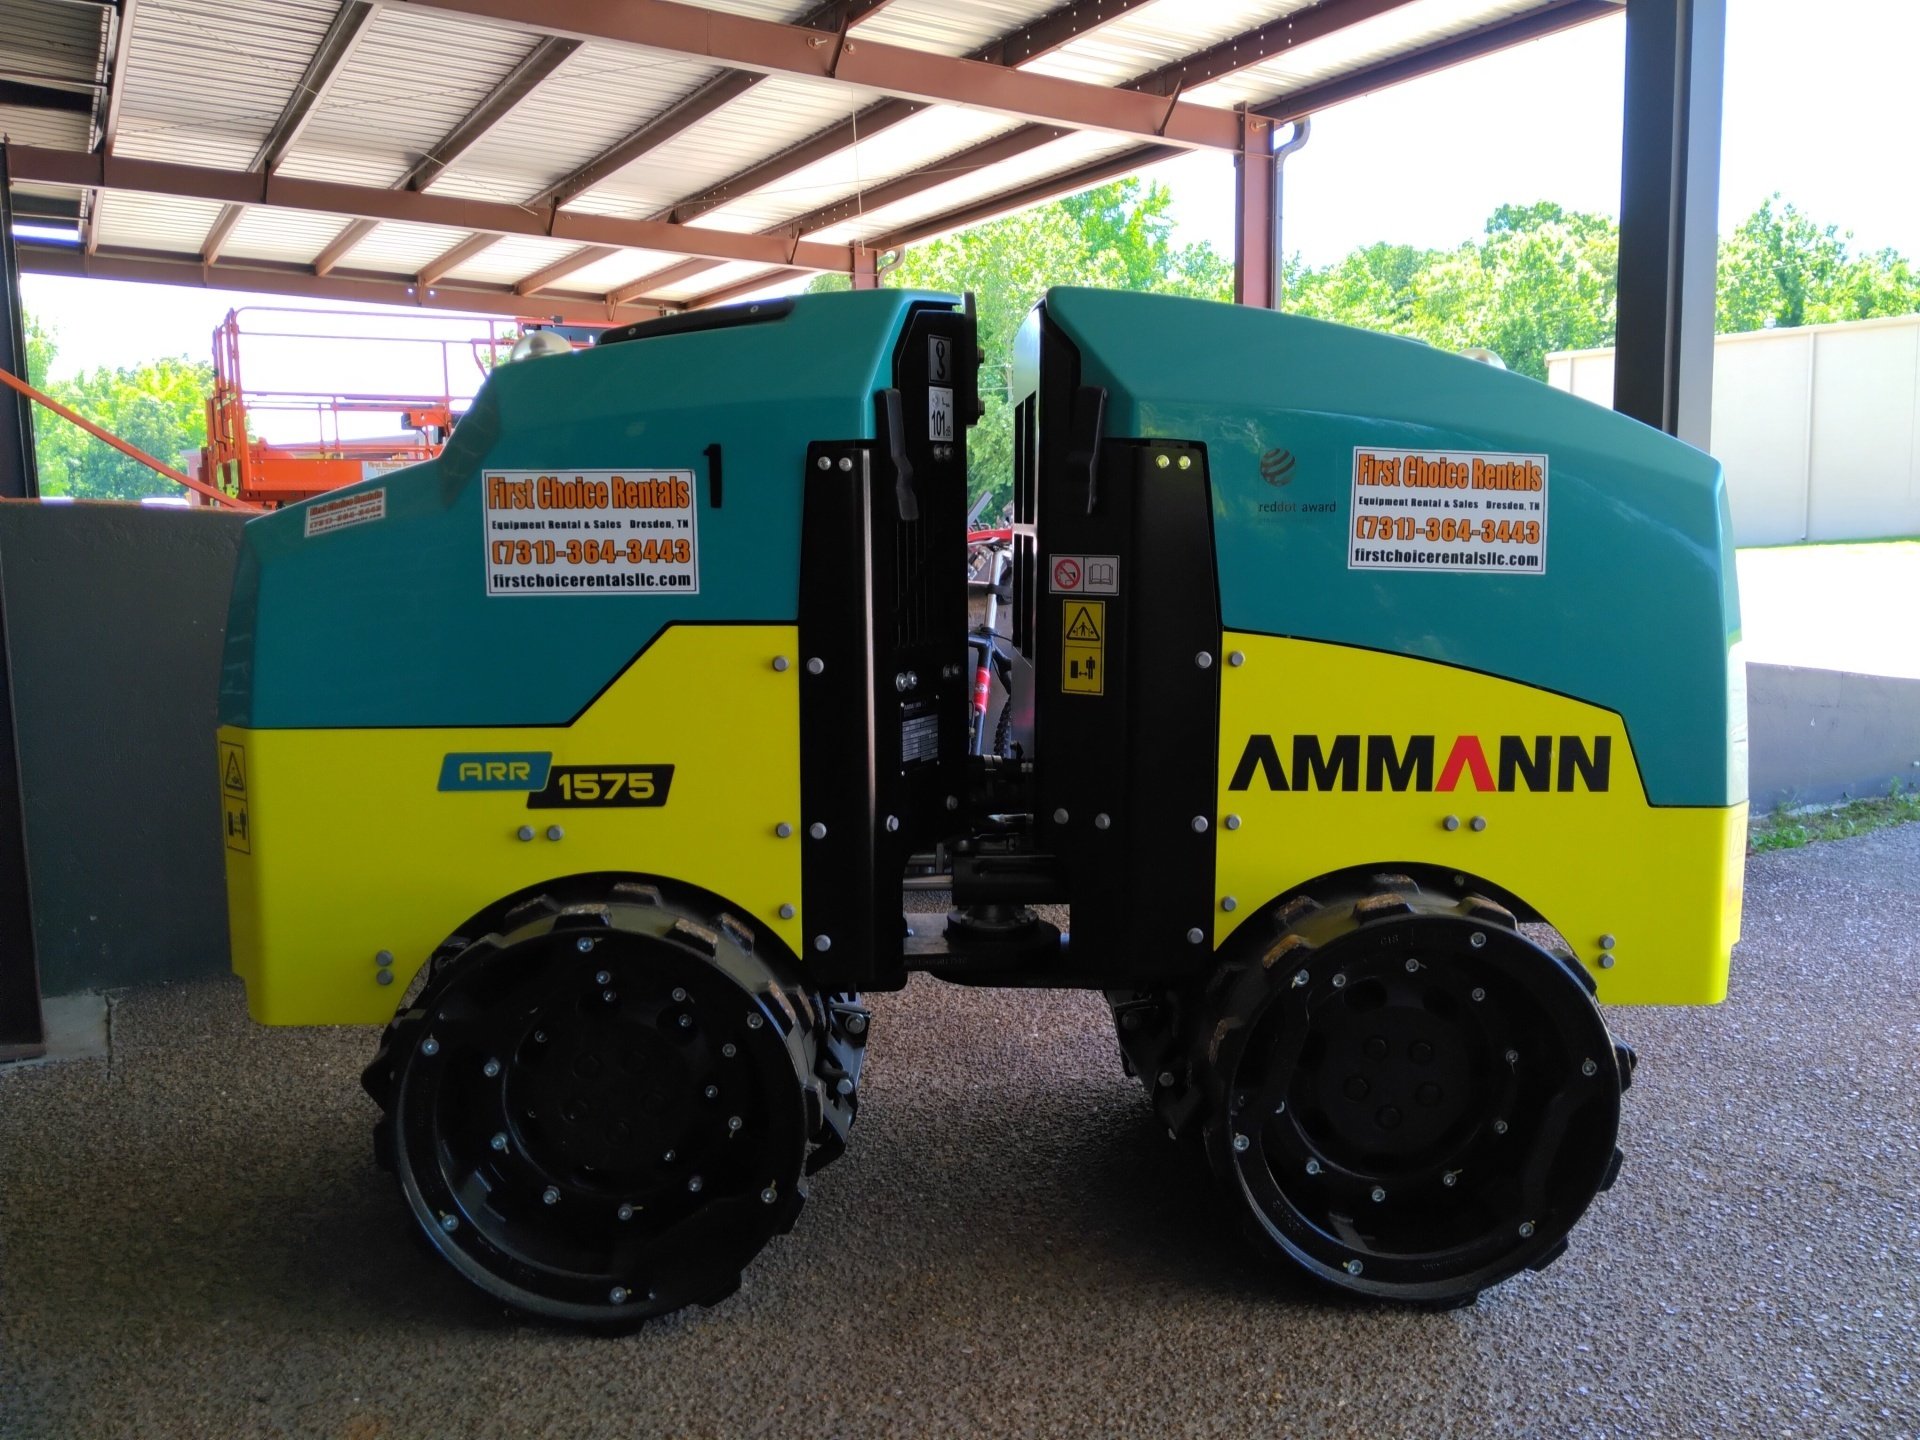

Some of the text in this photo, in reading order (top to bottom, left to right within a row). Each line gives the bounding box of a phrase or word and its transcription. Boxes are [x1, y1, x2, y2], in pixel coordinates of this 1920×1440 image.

[932, 410, 946, 437] 101
[1357, 454, 1542, 492] First Choice Rentals
[488, 476, 690, 509] First Choice Rentals
[1359, 496, 1540, 511] Equipment Rental & Sales Dresden, TN
[1258, 501, 1337, 512] reddot award
[492, 519, 689, 530] Equipment Rental & Sales Dresden, TN
[1356, 516, 1541, 544] (731)-364-3443
[492, 539, 691, 565] (731)-364-3443
[1355, 548, 1539, 567] firstchoicerentalsllc.com
[493, 573, 691, 588] firstchoicerentalsllc.com
[459, 762, 530, 781] ARR
[1228, 735, 1612, 792] AMMANN
[559, 773, 655, 800] 1575
